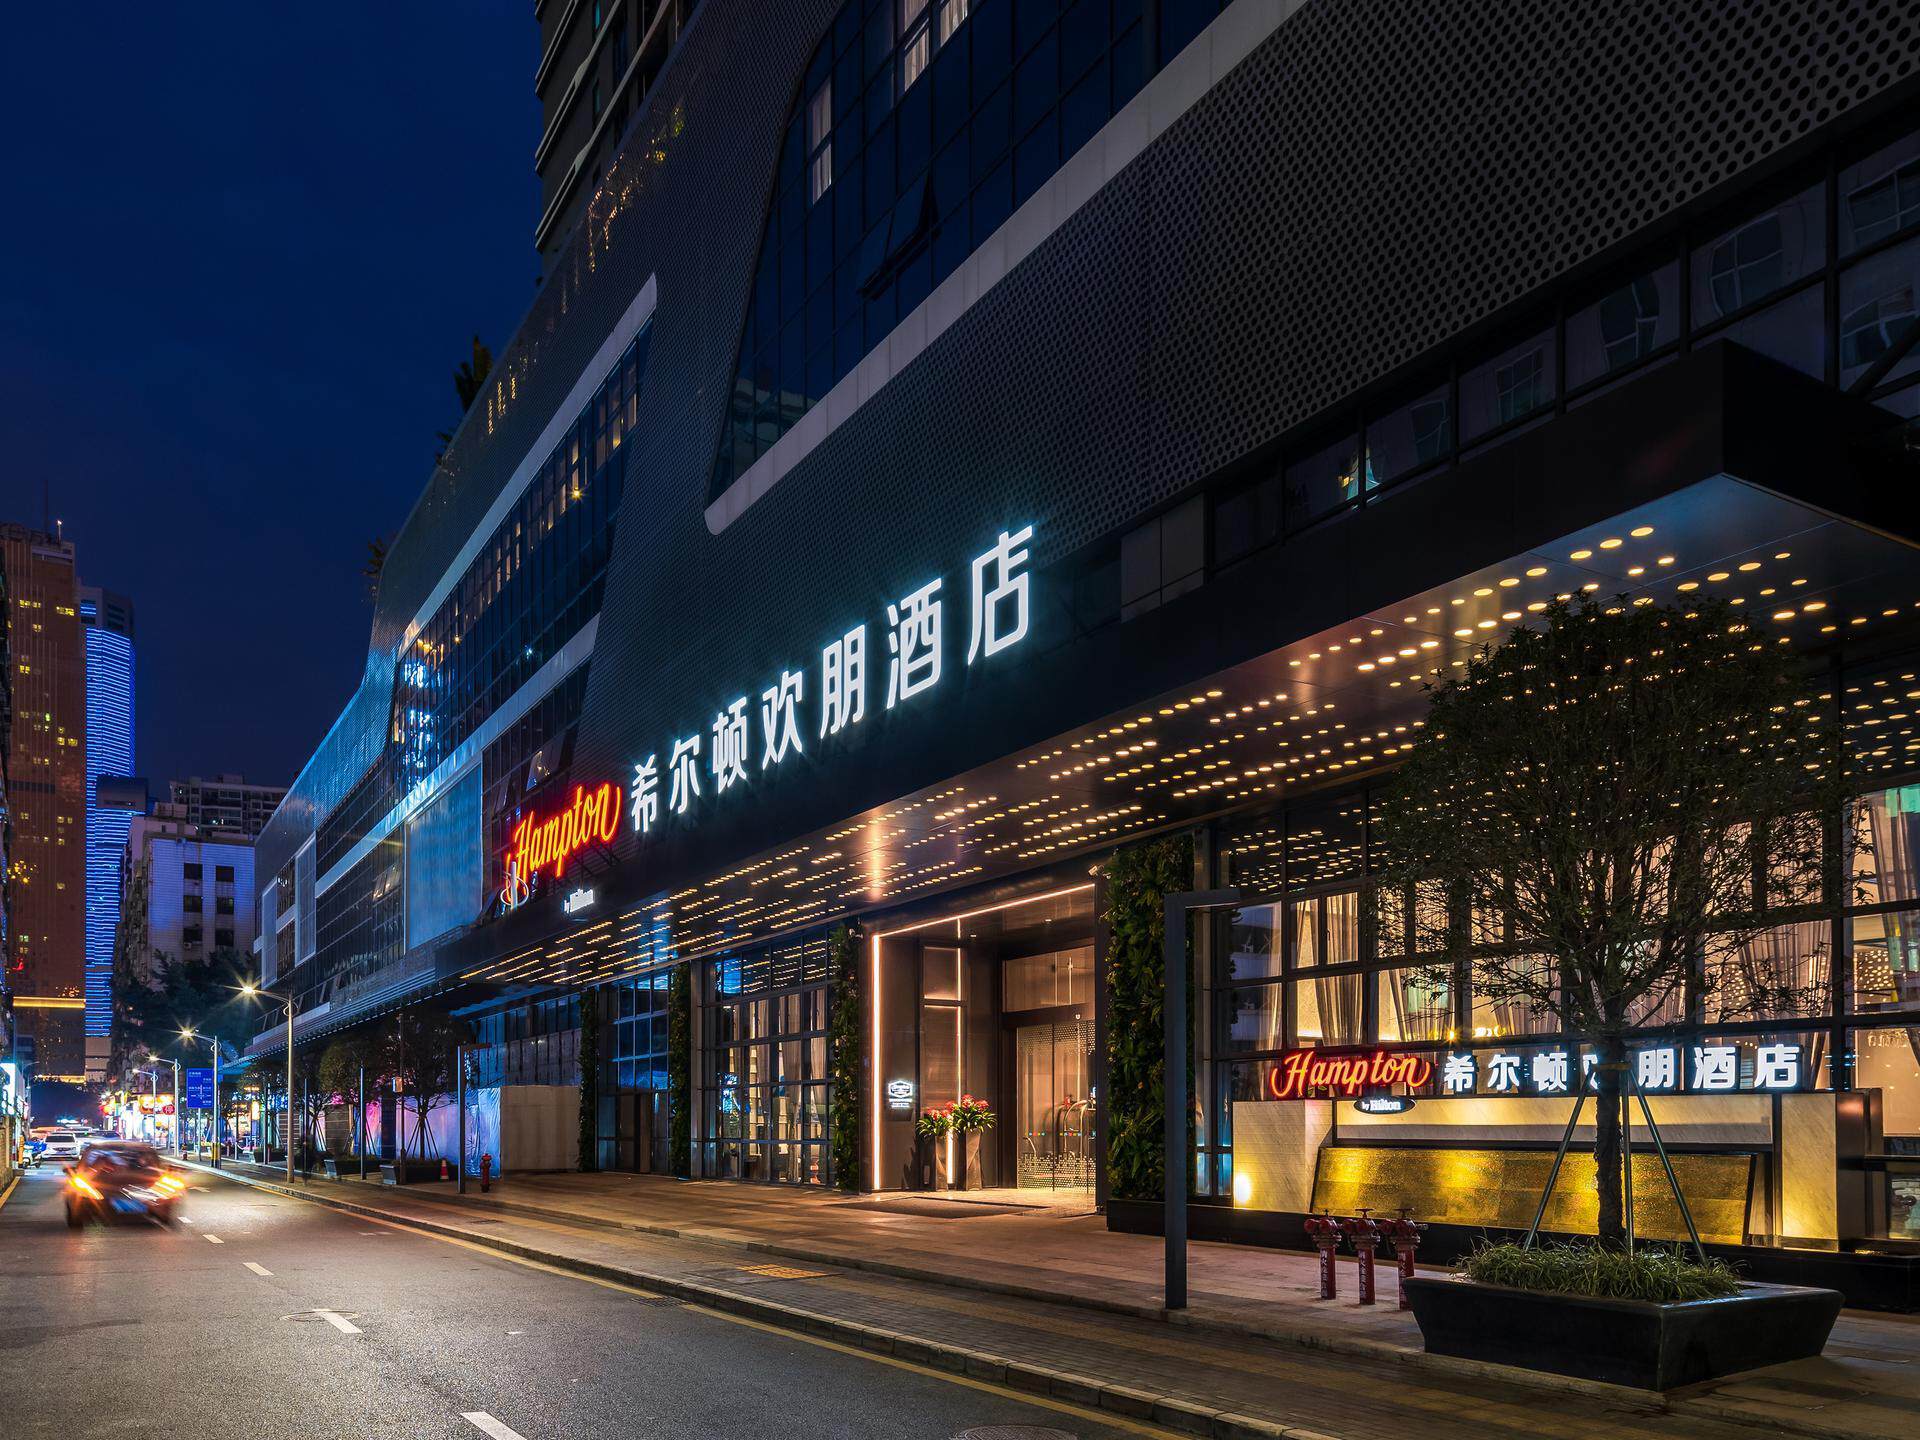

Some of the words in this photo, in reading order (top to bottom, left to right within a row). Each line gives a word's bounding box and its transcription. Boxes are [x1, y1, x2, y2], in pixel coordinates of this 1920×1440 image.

[631, 525, 1034, 834] 希尔顿欢朋酒店
[505, 783, 621, 901] Hampton
[1269, 1051, 1431, 1099] Hampton
[1443, 1043, 1801, 1093] 希尔顿朋酒店
